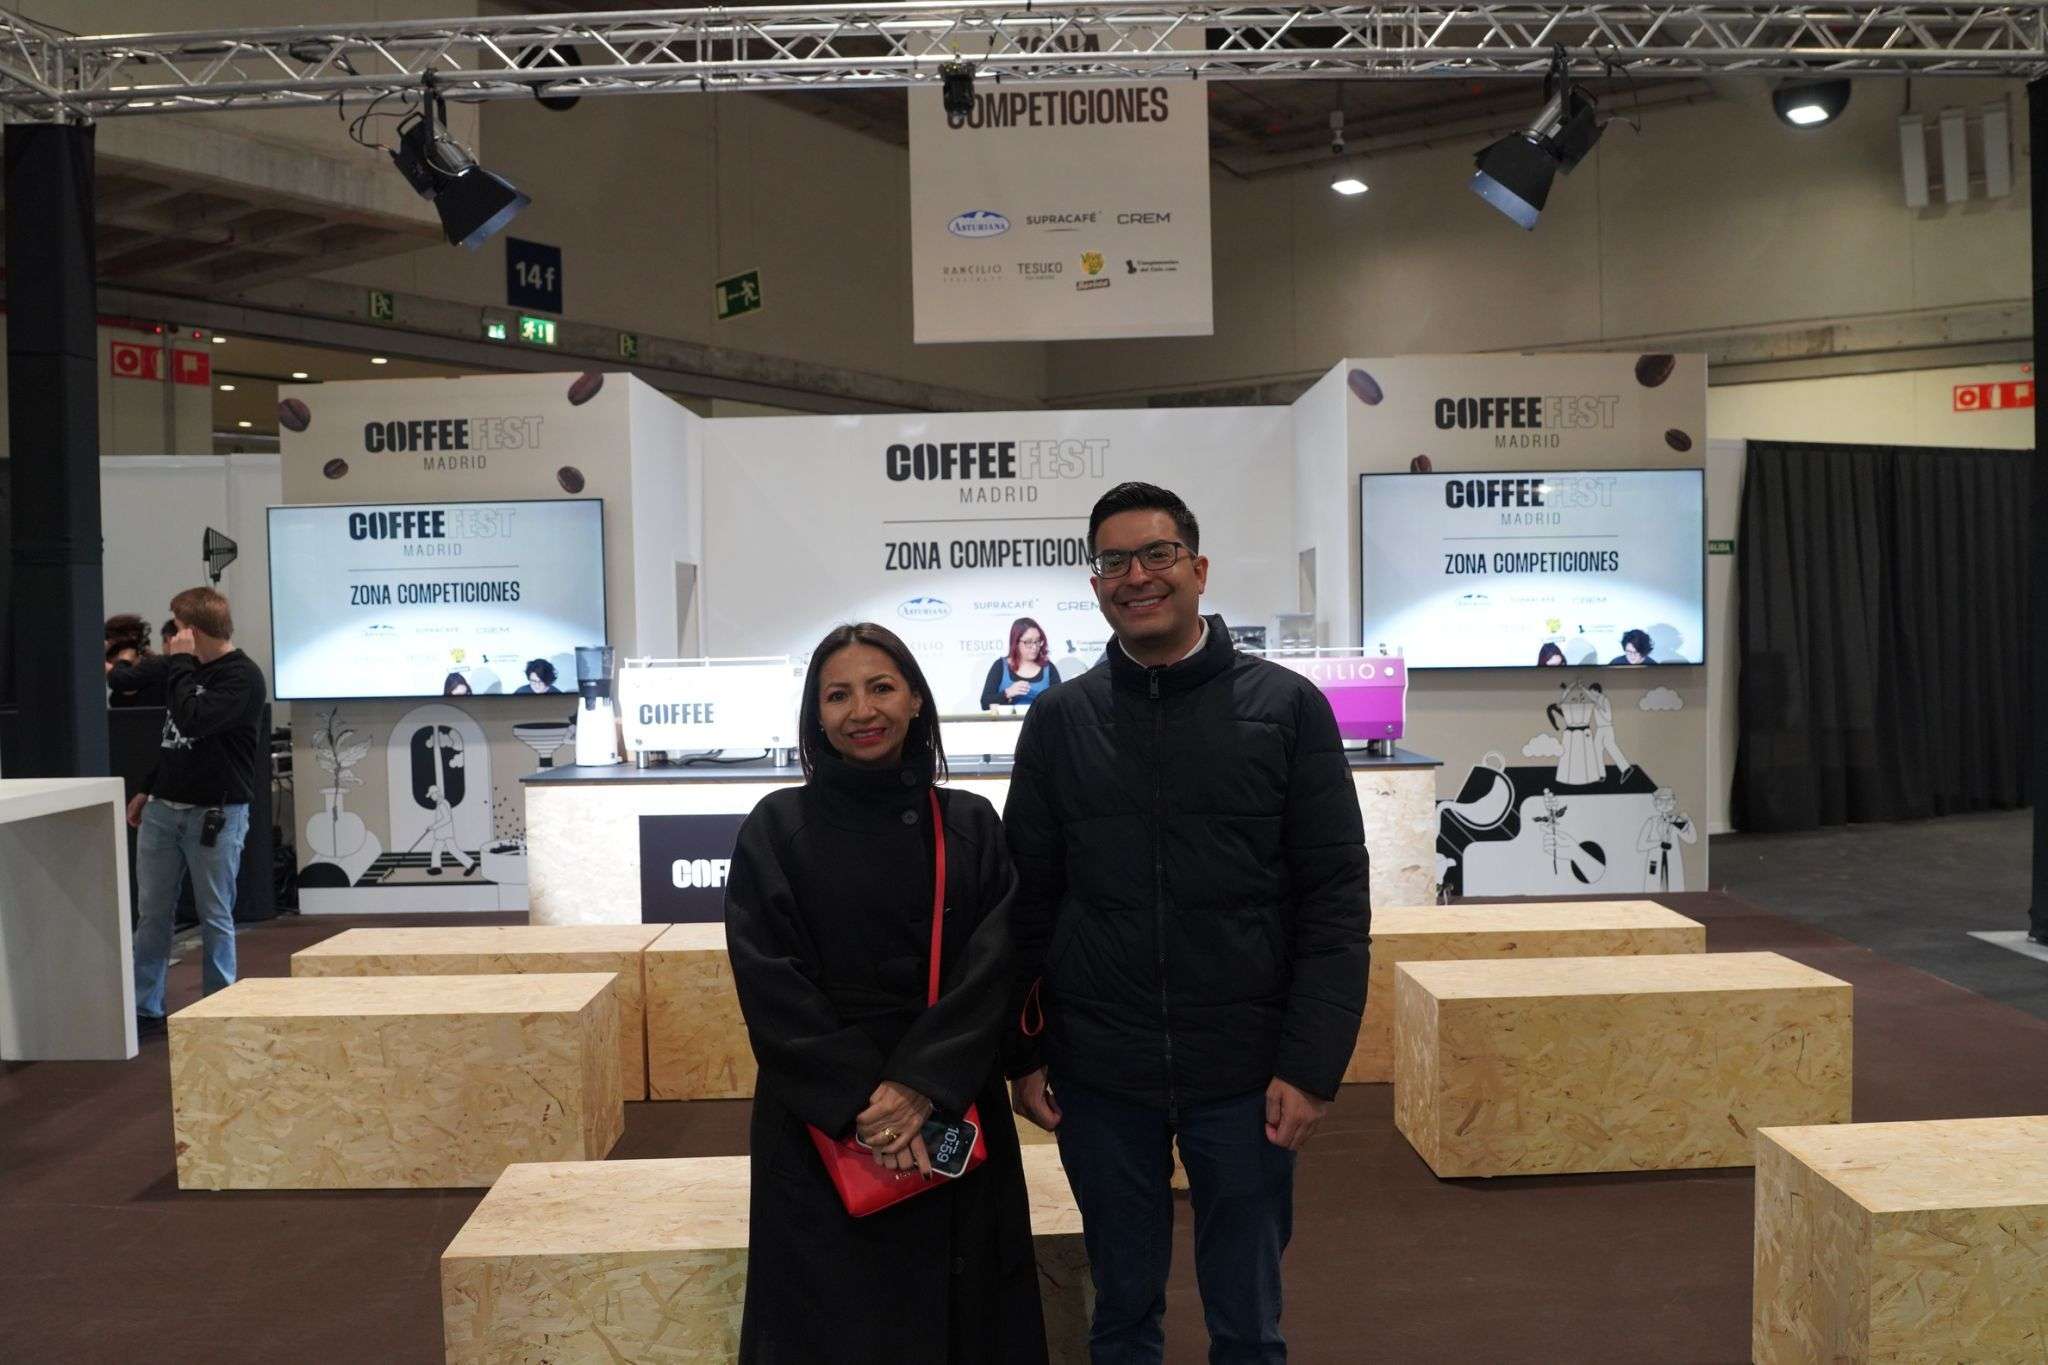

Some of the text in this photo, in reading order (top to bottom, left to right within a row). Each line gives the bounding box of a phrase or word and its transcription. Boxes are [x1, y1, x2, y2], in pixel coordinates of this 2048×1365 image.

[1117, 212, 1170, 225] CREM
[1016, 261, 1063, 274] TESUKO
[1495, 434, 1560, 448] MADRID
[424, 455, 487, 471] MADRID
[959, 485, 1038, 503] MADRID
[1501, 511, 1561, 526] MADRID
[403, 543, 462, 557] MADRID
[885, 537, 1092, 571] ZONA COMPETICION
[1445, 550, 1619, 574] ZONA COMPETICIONES
[351, 581, 520, 605] ZONA COMPETICIONES
[639, 703, 714, 725] COFFEE
[936, 1127, 960, 1163] 10:59
